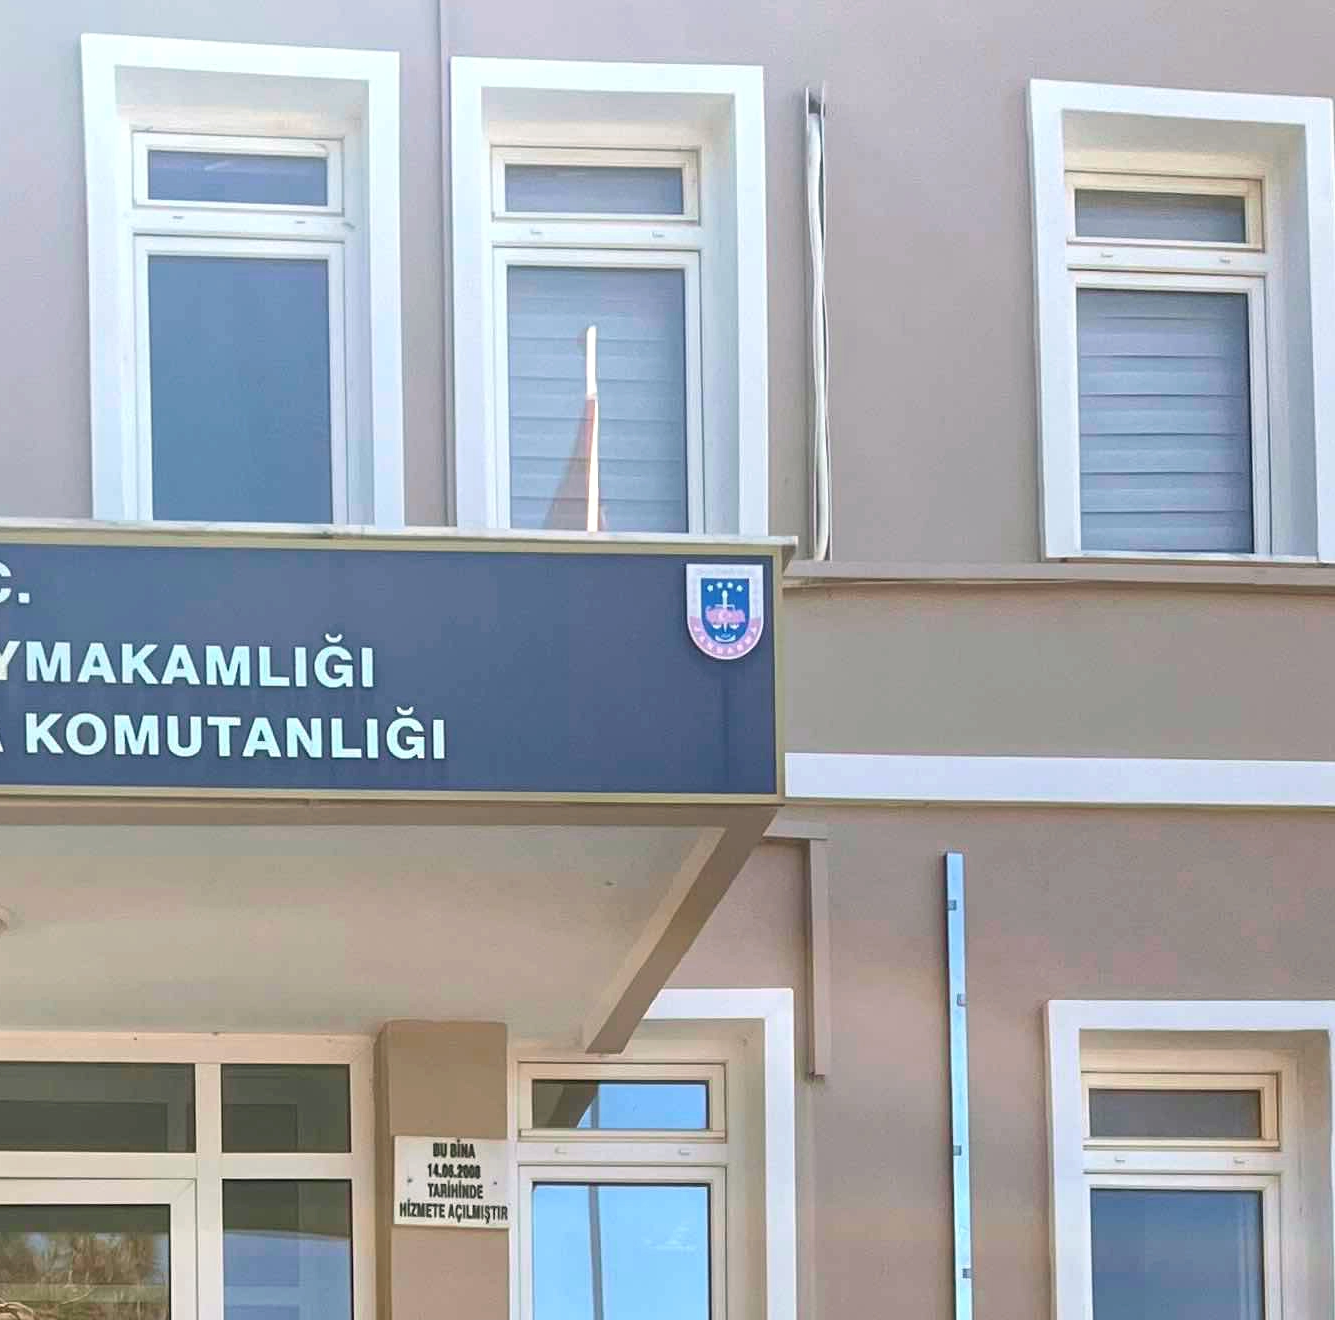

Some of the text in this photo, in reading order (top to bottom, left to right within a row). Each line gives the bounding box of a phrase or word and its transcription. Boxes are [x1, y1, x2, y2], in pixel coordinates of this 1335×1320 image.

[25, 705, 446, 760] KOMUTANLIĞI
[432, 1138, 476, 1159] BU BİNA
[427, 1180, 484, 1199] TARİHİNDE
[399, 1198, 509, 1224] HİZMETE AÇILMIŞTIR
